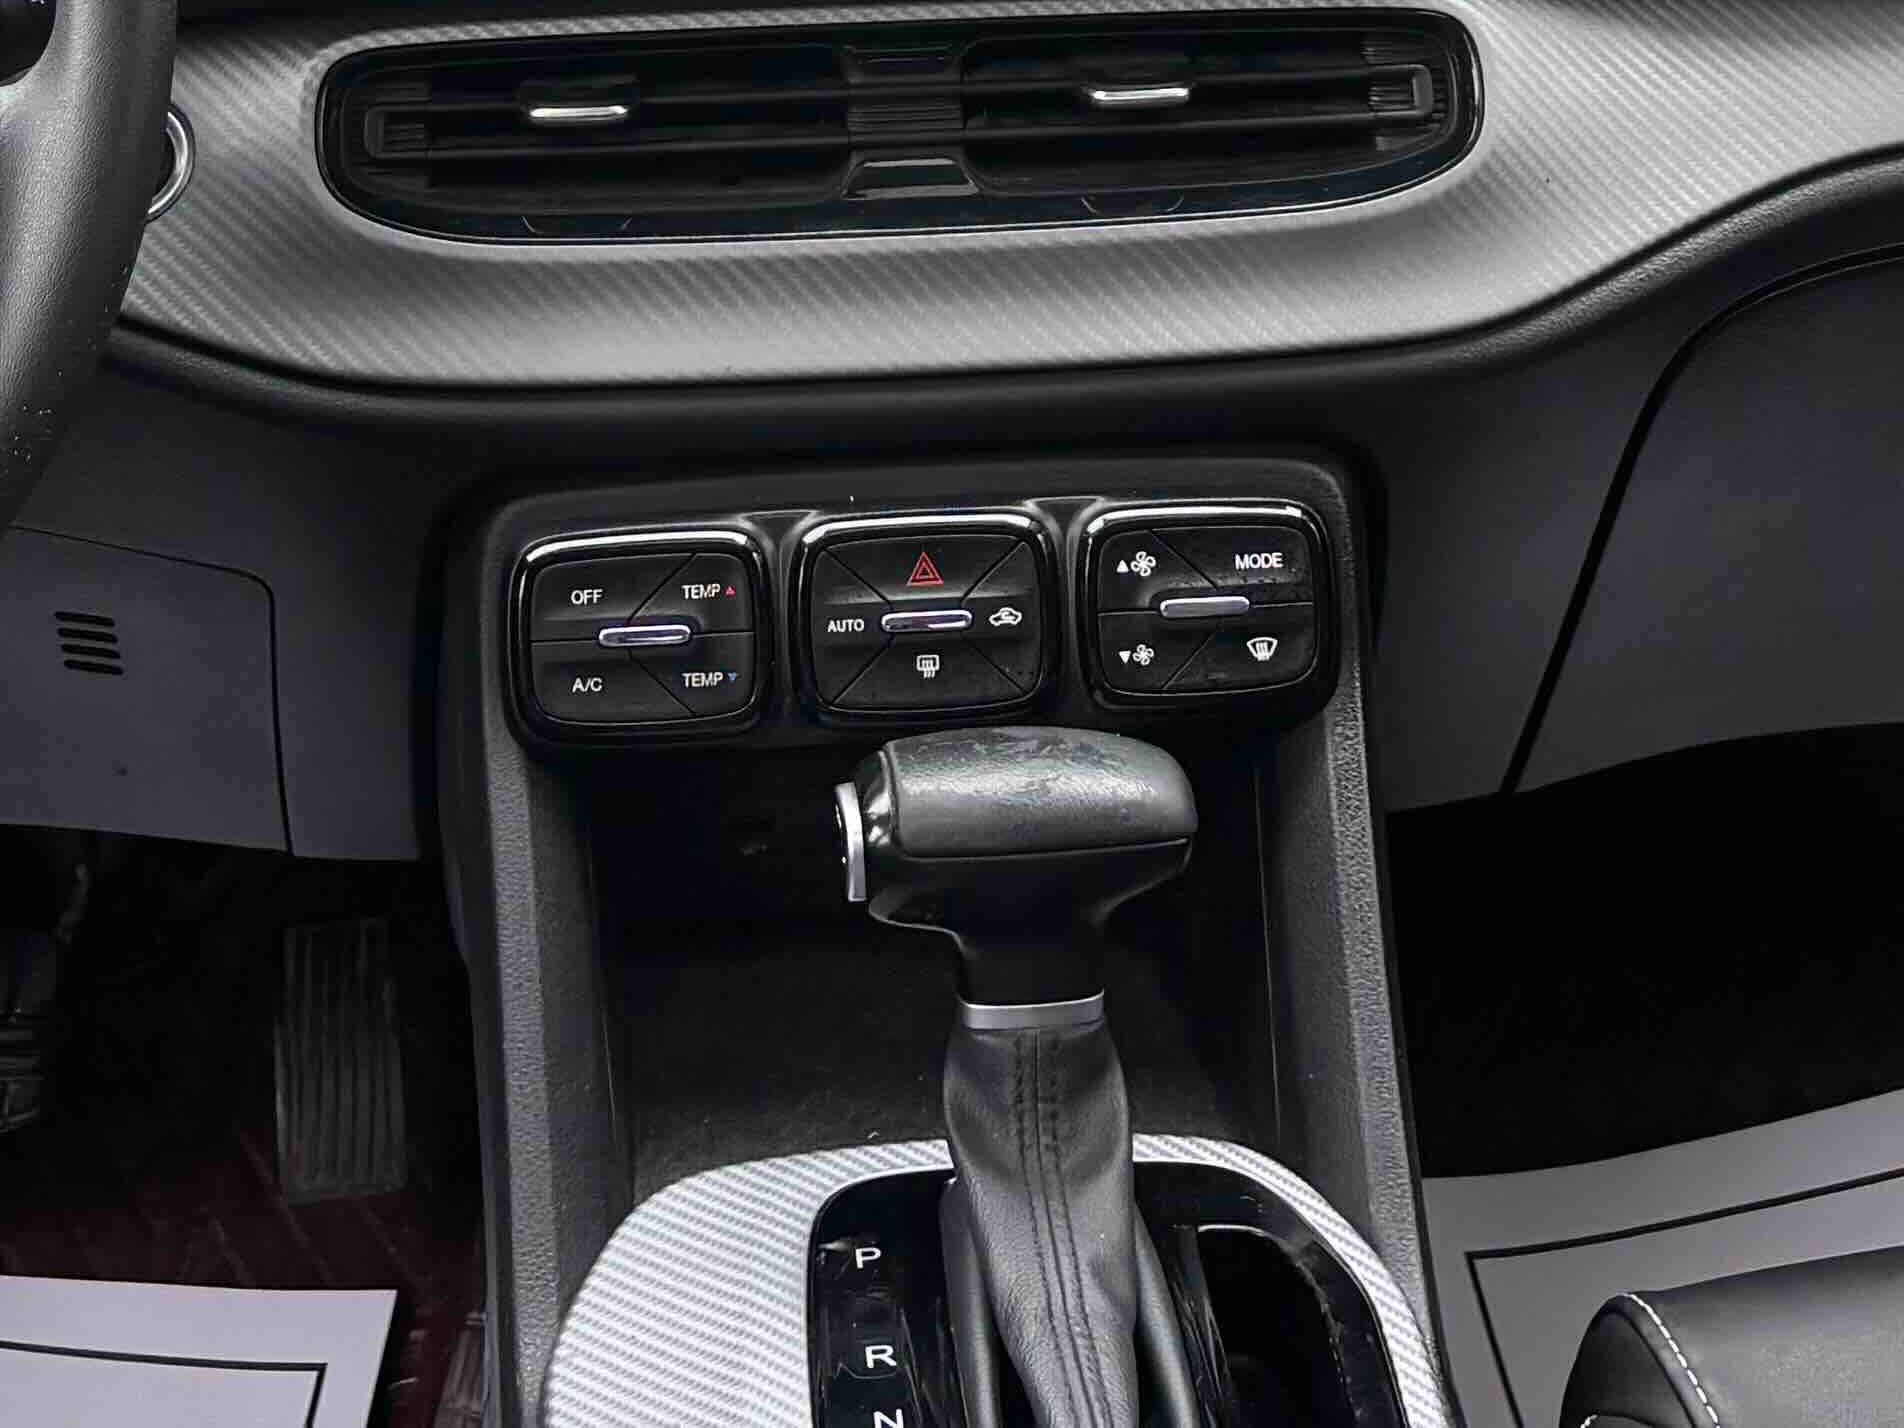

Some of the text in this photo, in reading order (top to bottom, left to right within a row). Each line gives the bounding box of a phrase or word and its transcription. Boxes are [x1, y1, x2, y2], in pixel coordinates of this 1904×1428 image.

[1234, 551, 1284, 571] MODE
[571, 583, 722, 605] OFF TEMP
[827, 618, 866, 634] AUTO
[572, 671, 725, 694] A/C TEMP
[854, 1246, 882, 1270] P
[864, 1344, 898, 1370] R
[872, 1407, 905, 1428] N
